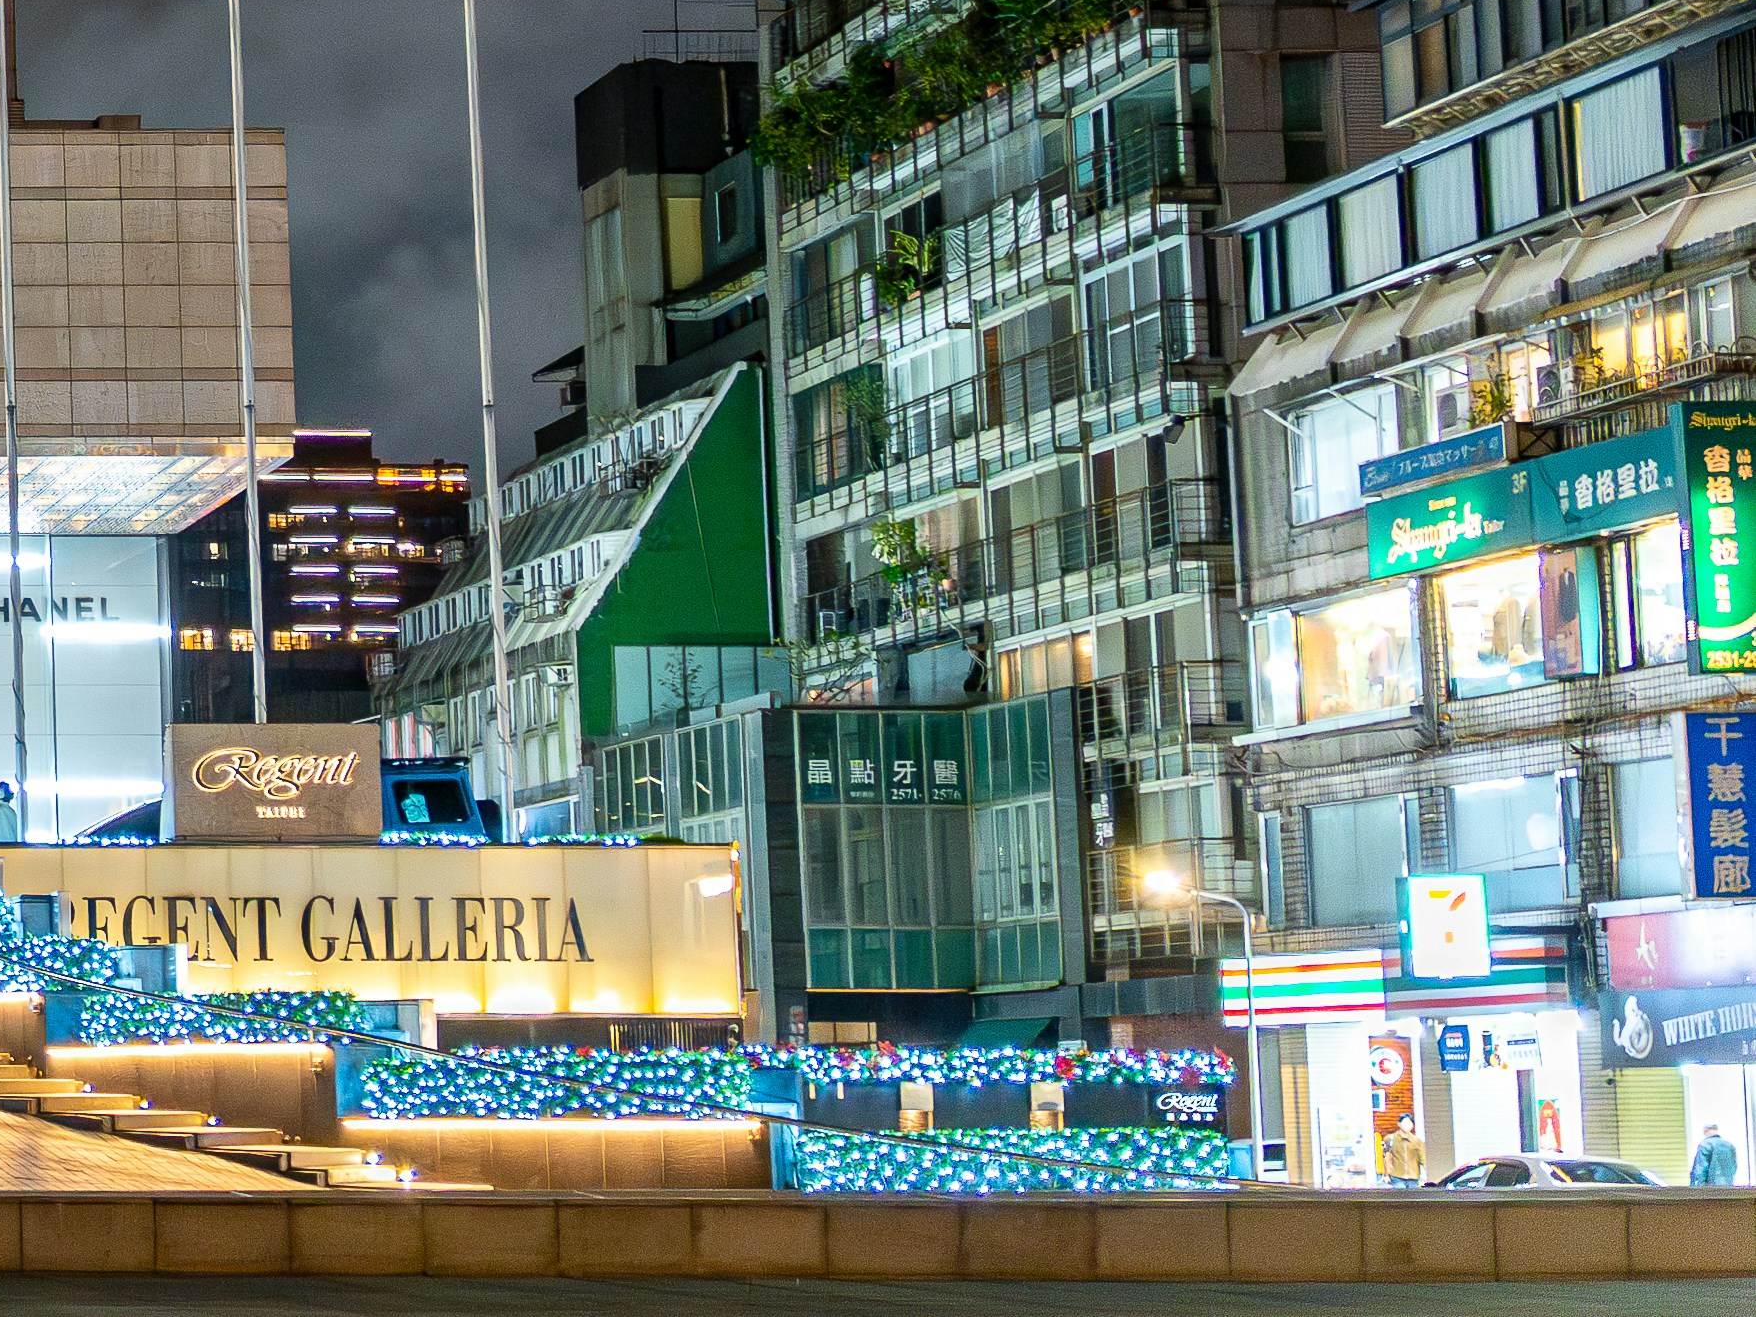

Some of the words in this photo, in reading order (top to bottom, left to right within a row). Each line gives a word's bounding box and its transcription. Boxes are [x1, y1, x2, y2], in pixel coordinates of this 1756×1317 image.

[1575, 458, 1661, 510] 香格里拉
[1703, 444, 1739, 566] 香格里拉
[192, 747, 361, 800] Regent
[807, 758, 959, 786] 晶點牙醫
[256, 805, 307, 819] TAIPEI
[1704, 717, 1751, 893] 千慧髮廊
[69, 895, 282, 963] EGENT
[301, 895, 595, 963] GALLERIA
[1661, 1009, 1716, 1047] WHITE
[1156, 1092, 1219, 1113] Regent
